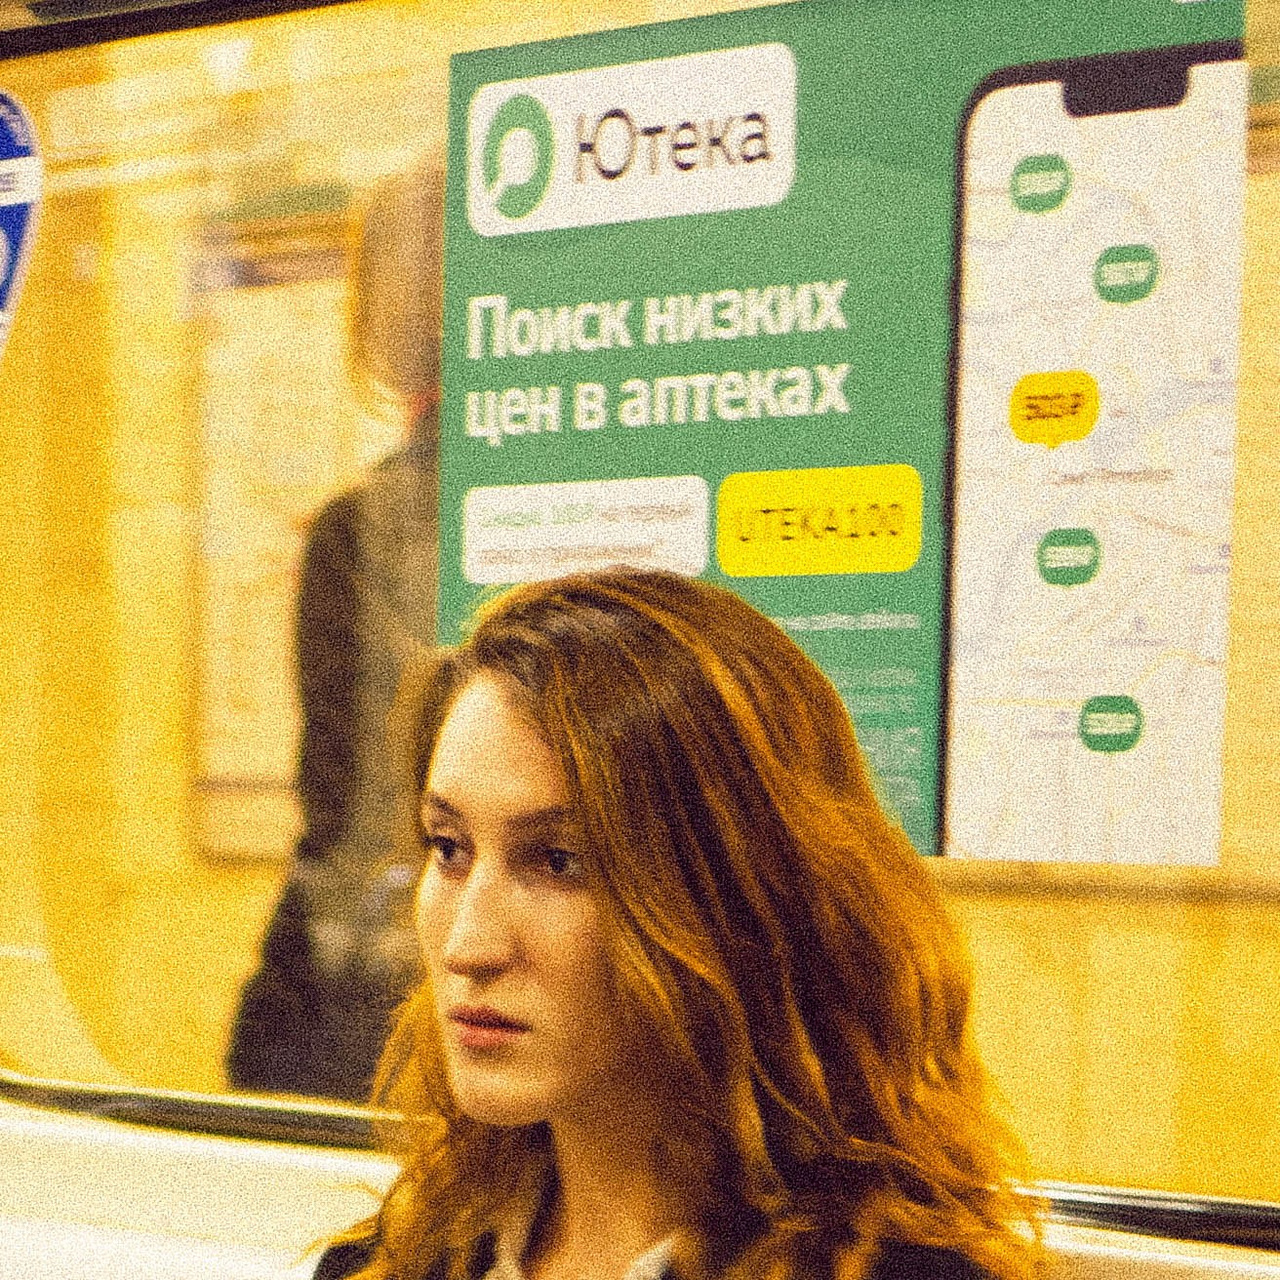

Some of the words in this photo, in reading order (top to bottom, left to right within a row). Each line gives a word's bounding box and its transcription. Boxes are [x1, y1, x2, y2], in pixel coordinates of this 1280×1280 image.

[574, 108, 773, 184] Ютека
[466, 293, 633, 359] Поиск
[642, 279, 848, 345] низких
[465, 386, 562, 446] цен
[573, 382, 606, 431] в
[618, 363, 852, 427] аптеках
